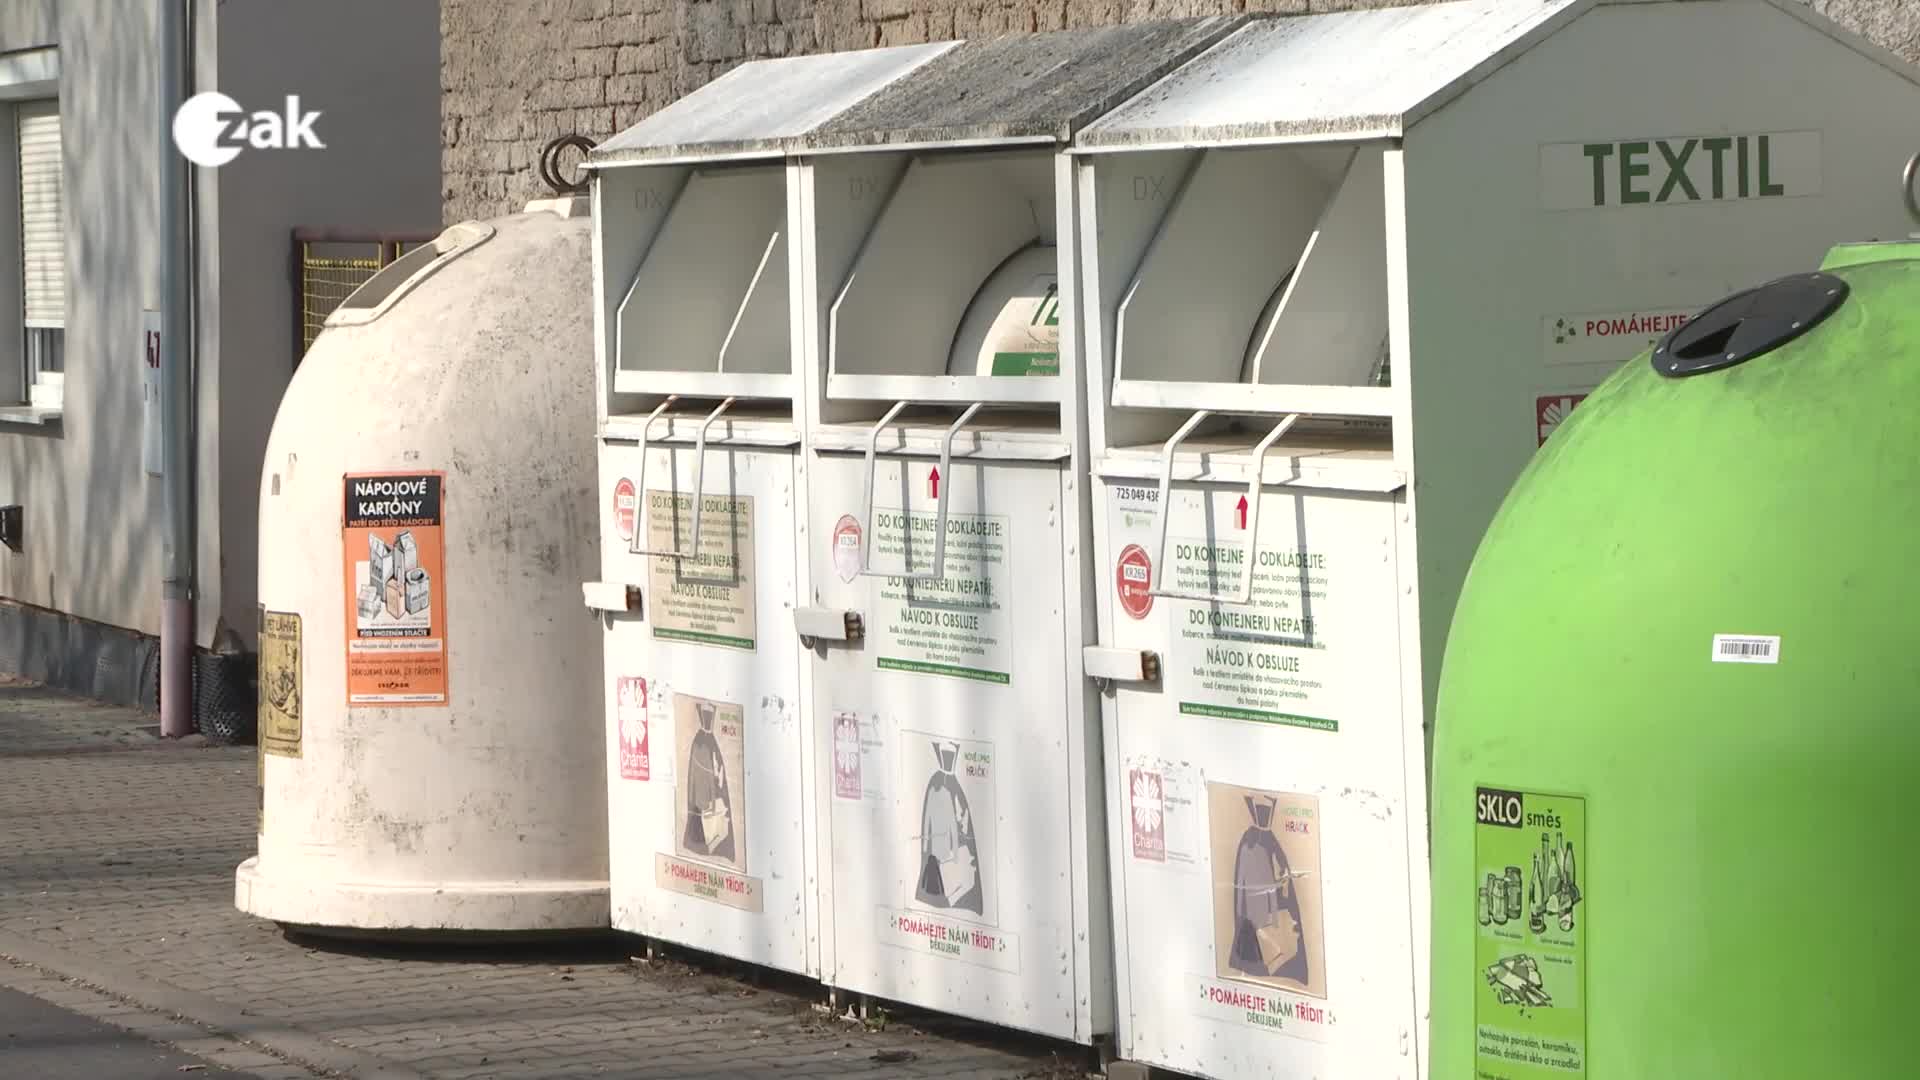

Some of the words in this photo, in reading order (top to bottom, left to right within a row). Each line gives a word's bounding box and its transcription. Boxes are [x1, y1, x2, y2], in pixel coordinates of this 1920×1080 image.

[1583, 135, 1784, 206] TEXTIL
[355, 477, 427, 496] NÁPOJOVÉ
[1116, 487, 1130, 500] 725
[1131, 488, 1145, 501] 049
[878, 513, 890, 529] DO
[947, 517, 1003, 537] ODKLÁDEJTE:
[1176, 544, 1191, 560] DO
[1194, 545, 1244, 564] KONTEJNE
[1260, 548, 1327, 569] ODKLÁDEJTE:
[935, 612, 941, 626] K
[942, 613, 979, 630] OBSLUZE
[1189, 608, 1205, 625] DO
[1208, 609, 1270, 632] KONTEJNERU
[1274, 615, 1318, 636] NEPATŘÍ:
[1206, 644, 1244, 667] NÁVOD
[1247, 653, 1254, 667] K
[1256, 653, 1299, 673] OBSLUZE
[1477, 793, 1521, 824] SKLO
[1526, 808, 1561, 829] směs
[898, 917, 946, 940] POMÁHEJTE
[948, 926, 970, 945] NÁM
[971, 930, 995, 951] TŘÍDIT
[929, 938, 960, 955] DĚKUJEME
[1209, 987, 1266, 1012] POMÁHEJTE
[1268, 997, 1293, 1018] NÁM
[1295, 1002, 1324, 1024] TŘÍDIT
[1246, 1011, 1283, 1029] DĚKUJEME
